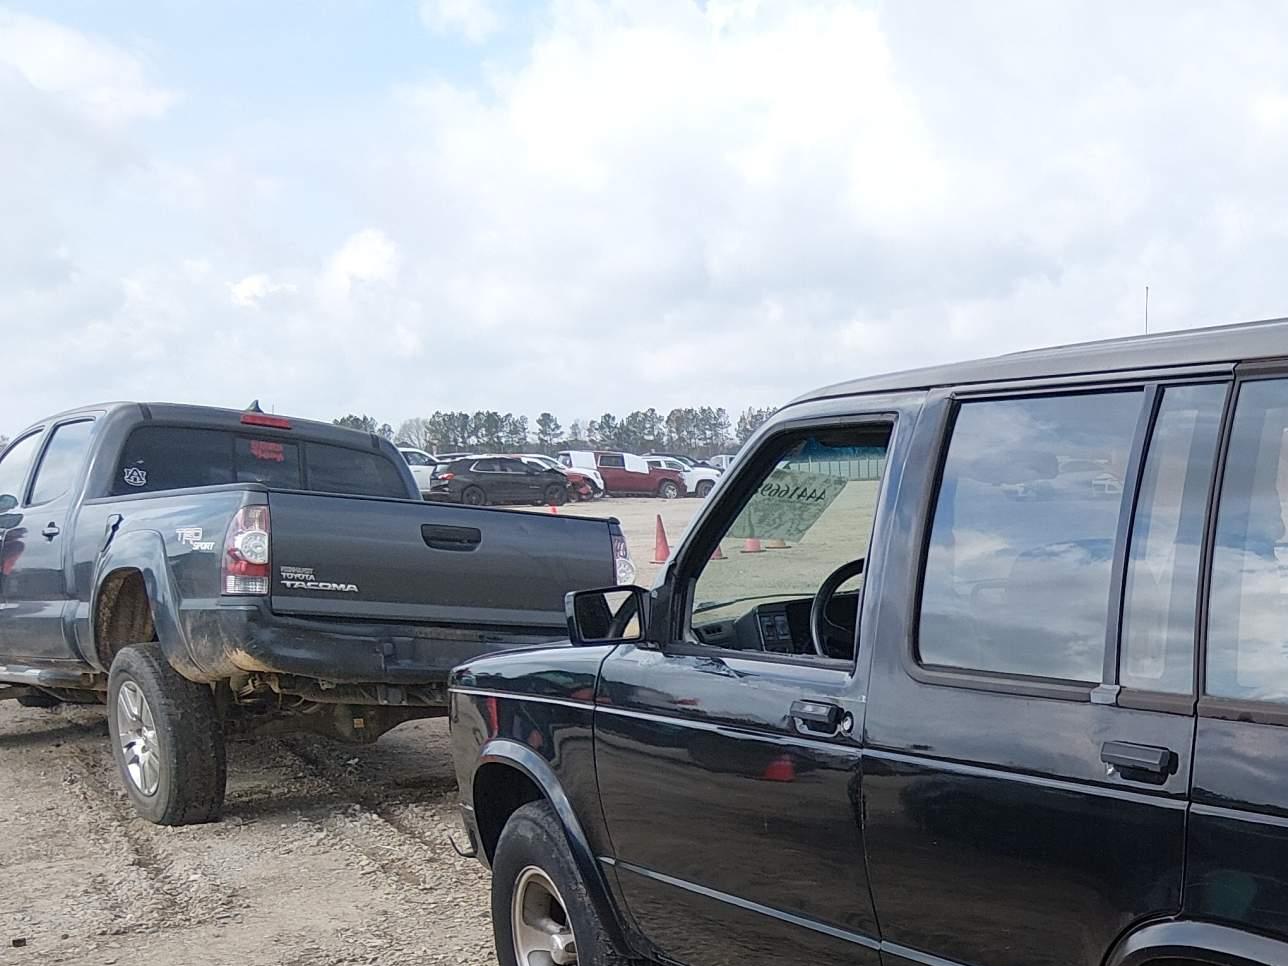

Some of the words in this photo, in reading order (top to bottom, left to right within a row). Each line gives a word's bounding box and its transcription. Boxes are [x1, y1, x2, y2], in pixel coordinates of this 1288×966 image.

[176, 528, 203, 544] TRD
[192, 541, 216, 551] SPORT
[280, 572, 316, 581] TOYOTA
[280, 580, 359, 592] TACOMA
